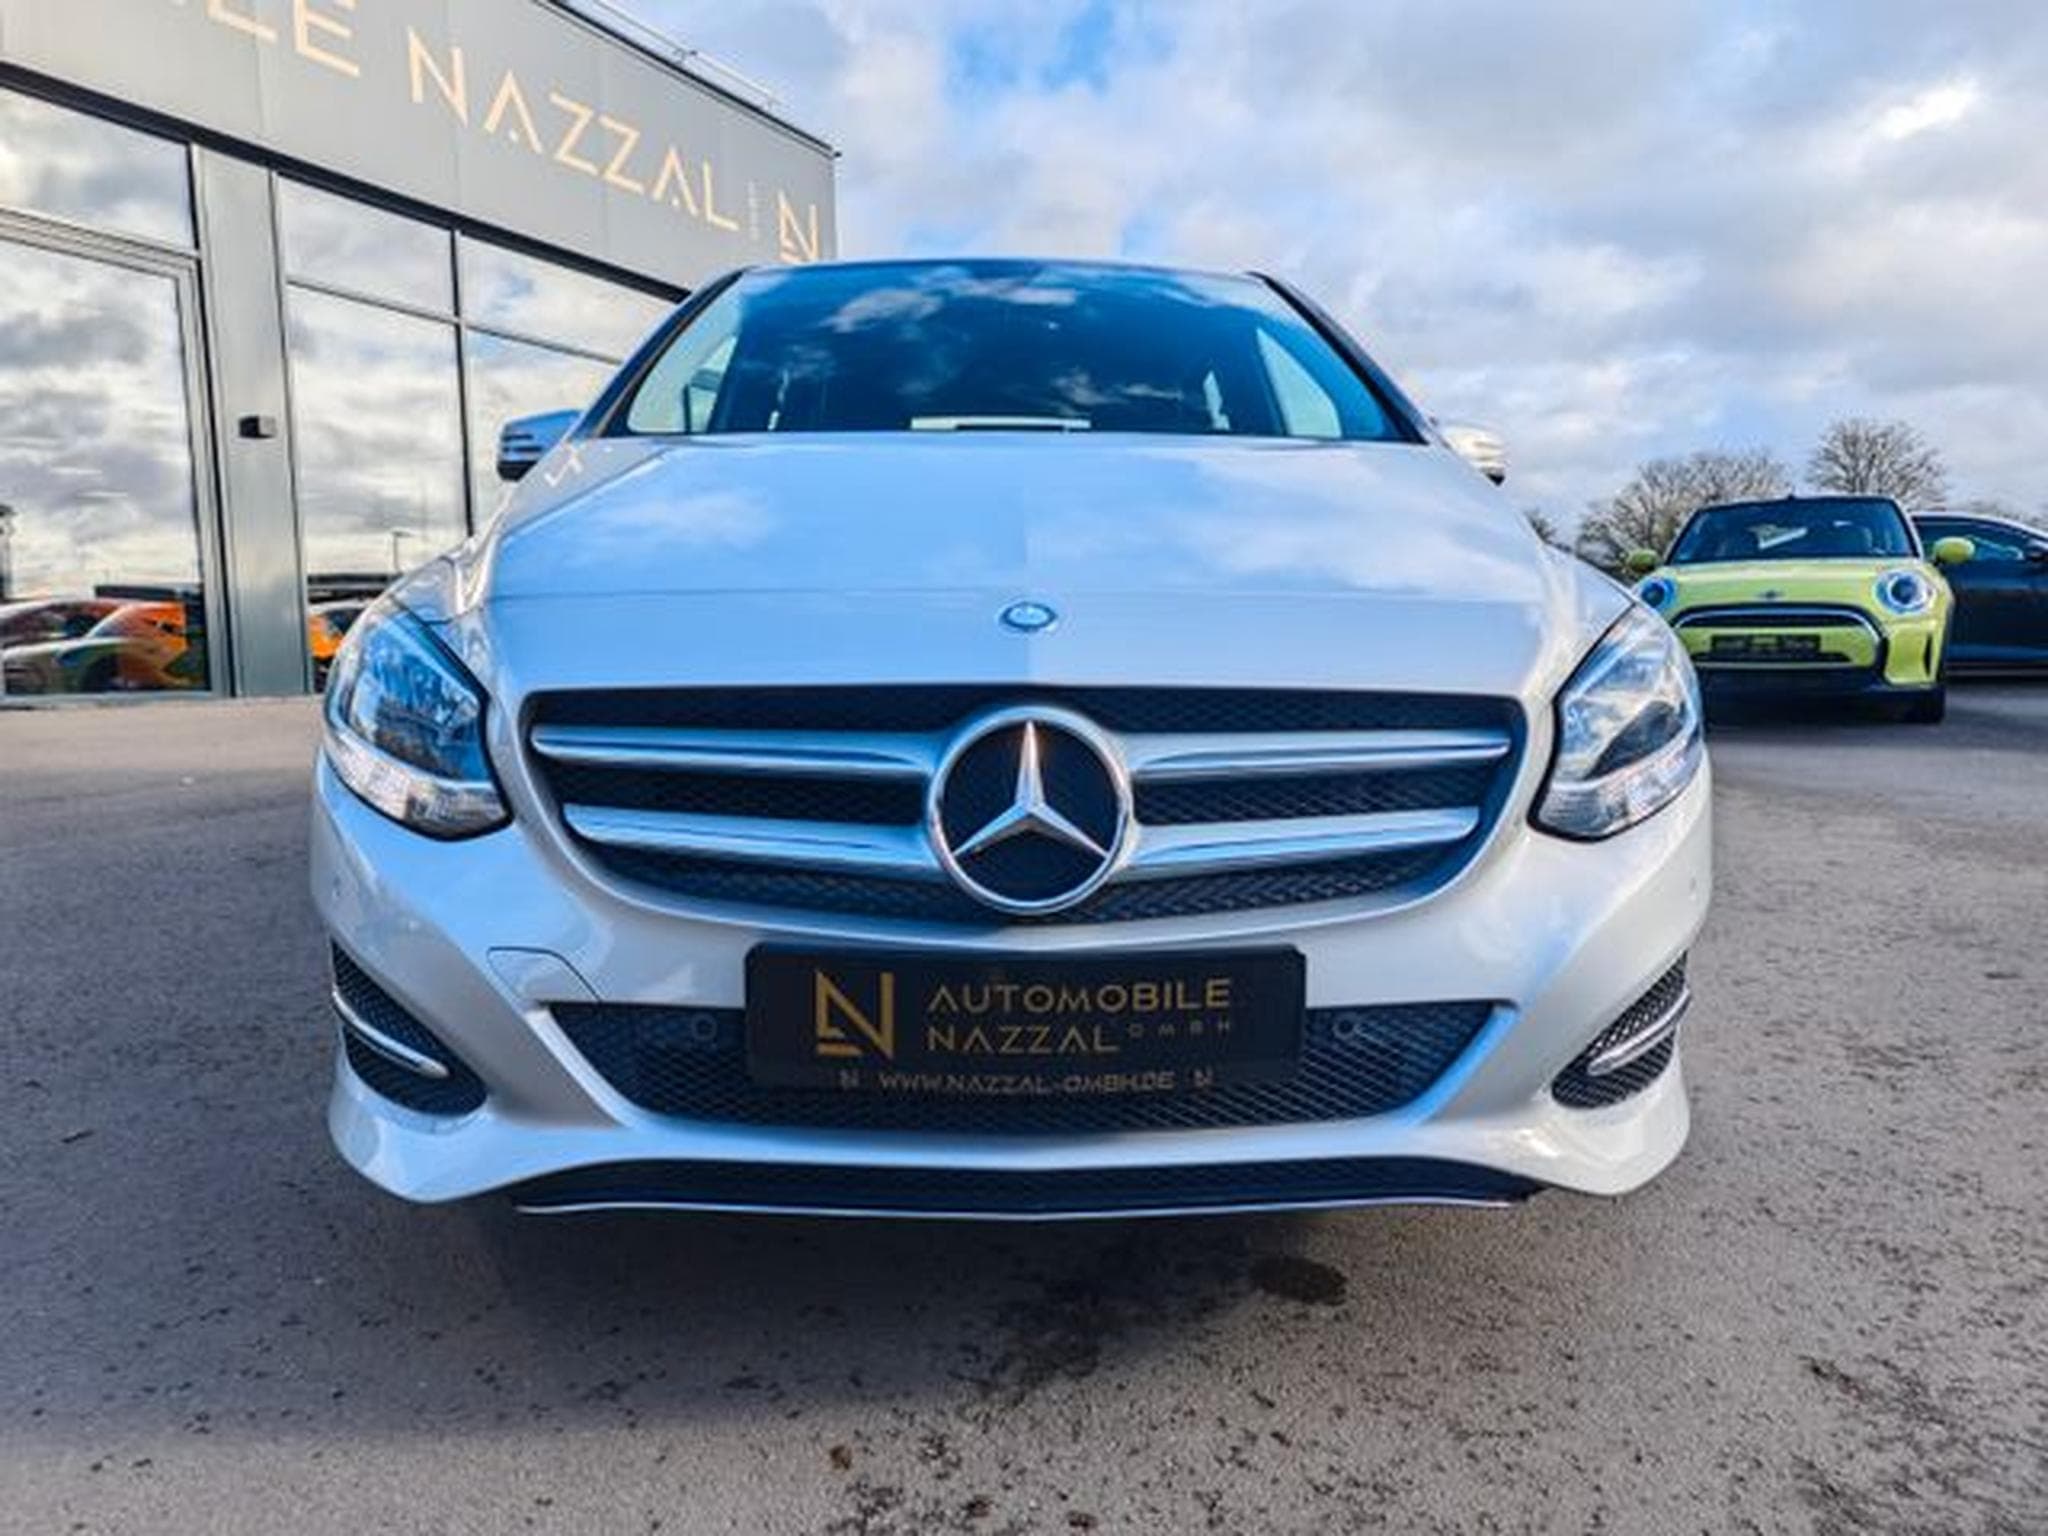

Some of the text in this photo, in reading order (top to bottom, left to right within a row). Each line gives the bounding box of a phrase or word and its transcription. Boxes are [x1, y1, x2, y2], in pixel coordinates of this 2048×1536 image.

[406, 24, 741, 231] NAZZAL
[928, 978, 1232, 1014] AUTOMOBILE
[928, 1023, 1120, 1055] NAZZAL
